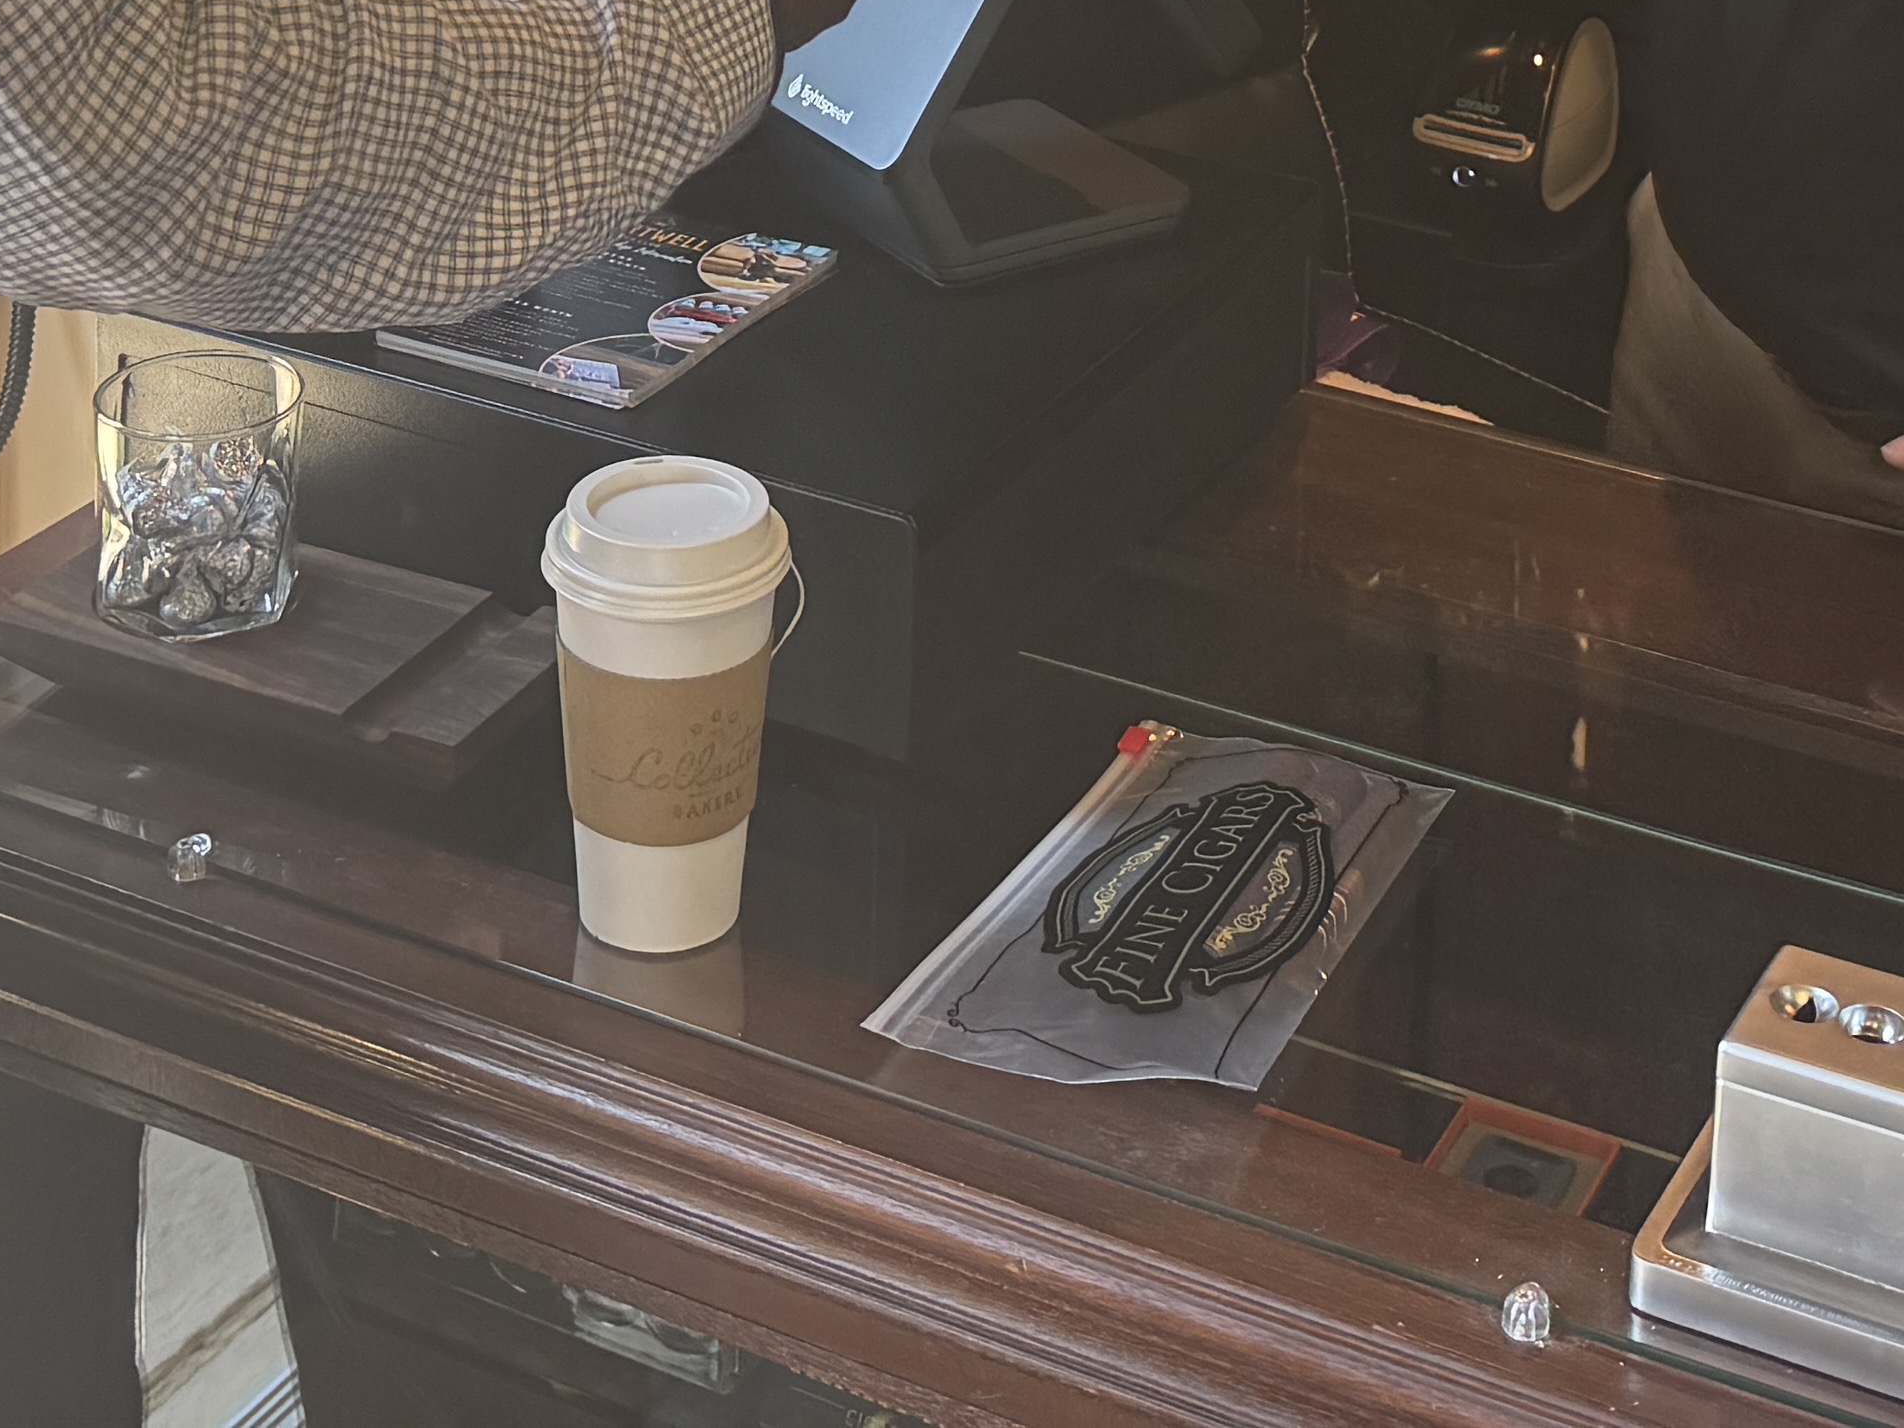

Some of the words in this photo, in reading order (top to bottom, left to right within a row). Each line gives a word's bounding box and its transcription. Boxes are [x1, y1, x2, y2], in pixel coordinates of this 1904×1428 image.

[800, 83, 855, 125] lightspeed
[1161, 791, 1275, 895] CIGARS
[1092, 903, 1189, 992] FINE
